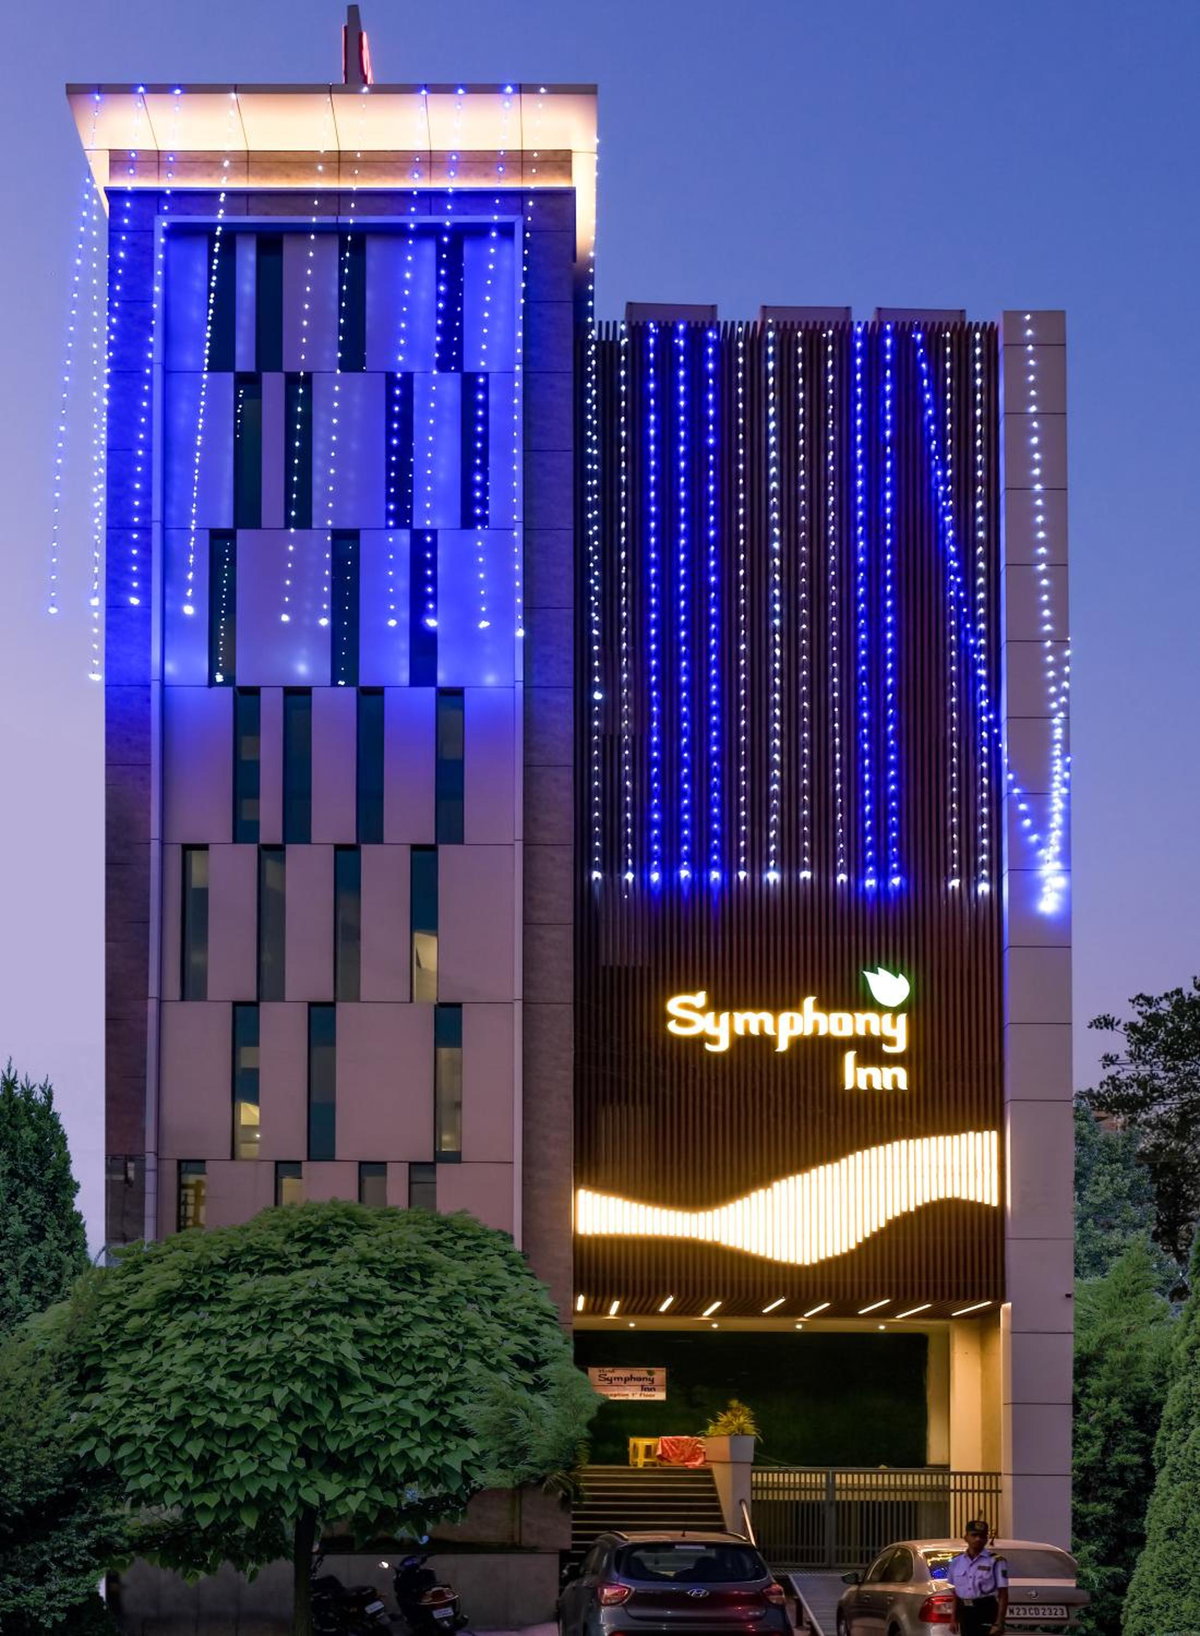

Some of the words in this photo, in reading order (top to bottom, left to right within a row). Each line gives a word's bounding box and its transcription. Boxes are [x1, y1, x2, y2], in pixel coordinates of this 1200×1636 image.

[666, 990, 908, 1053] Symphony
[844, 1050, 908, 1091] Inn
[598, 1373, 655, 1385] Symphony
